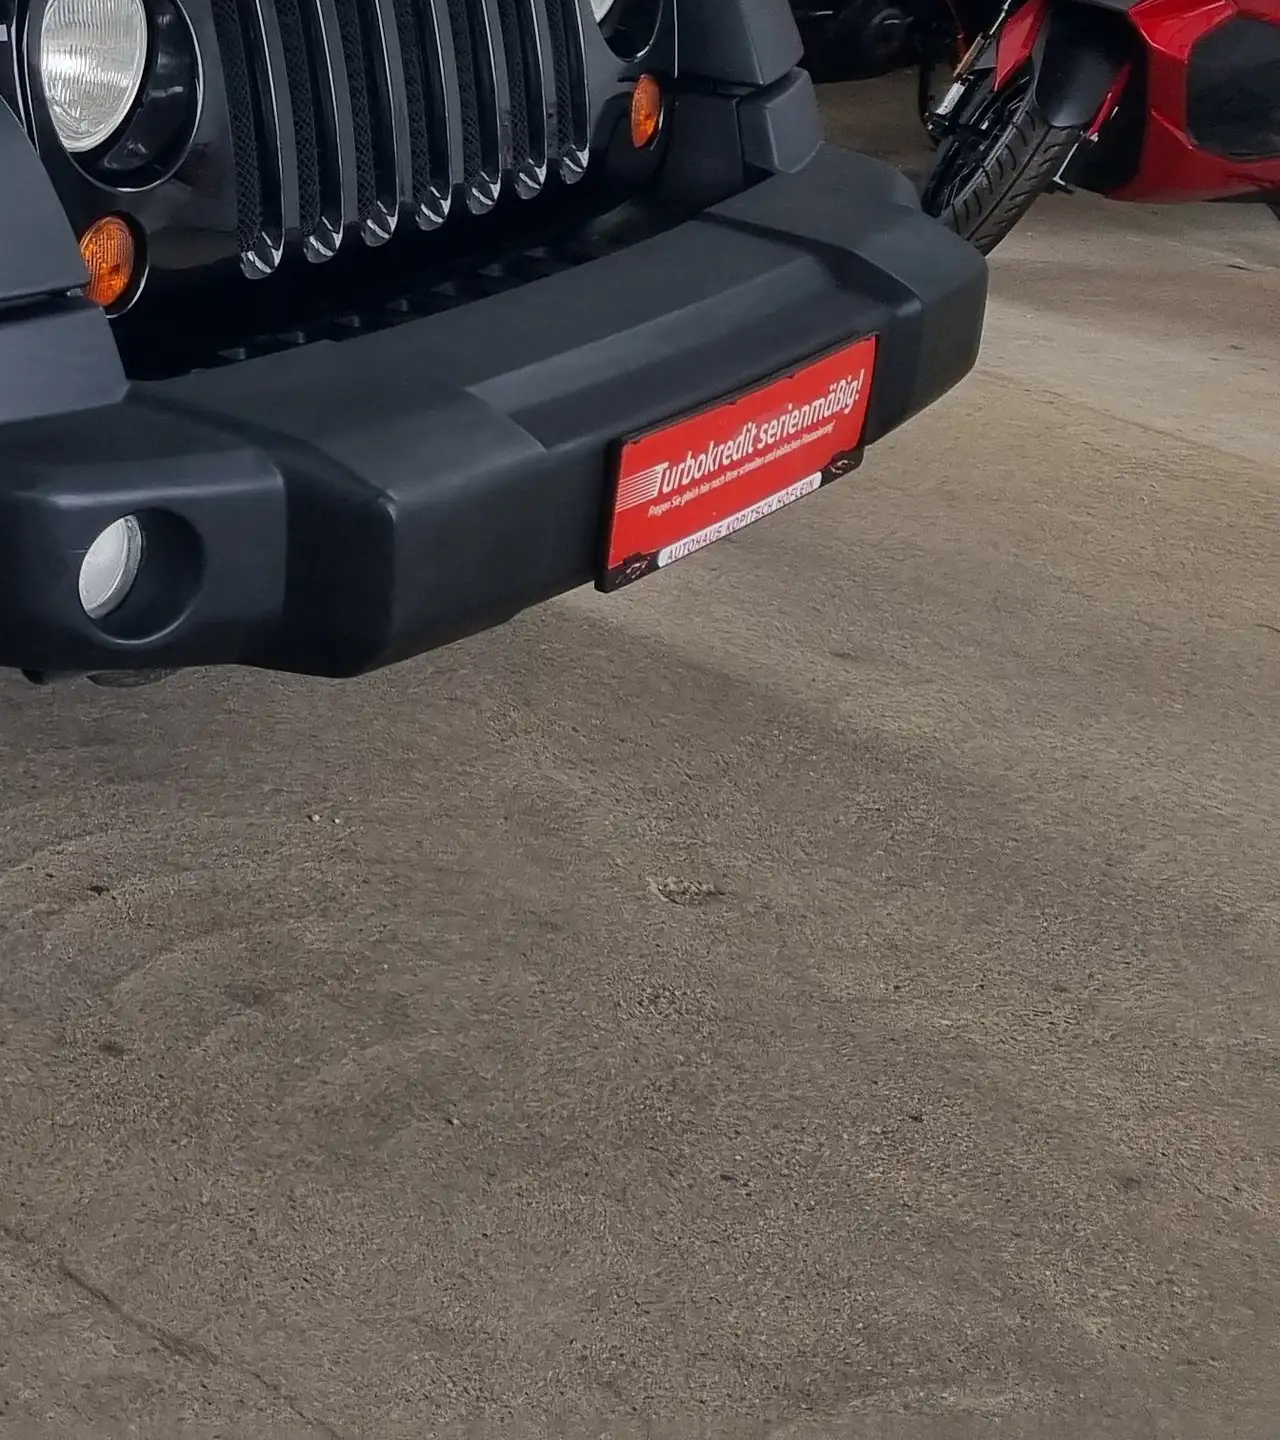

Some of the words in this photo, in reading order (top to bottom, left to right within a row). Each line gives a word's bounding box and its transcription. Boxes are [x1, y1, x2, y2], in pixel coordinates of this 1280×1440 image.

[650, 421, 758, 498] Turbokredit
[757, 368, 865, 449] serienmäßig!
[666, 526, 723, 562] AUTOHAUS
[725, 498, 774, 534] KOPITSCH
